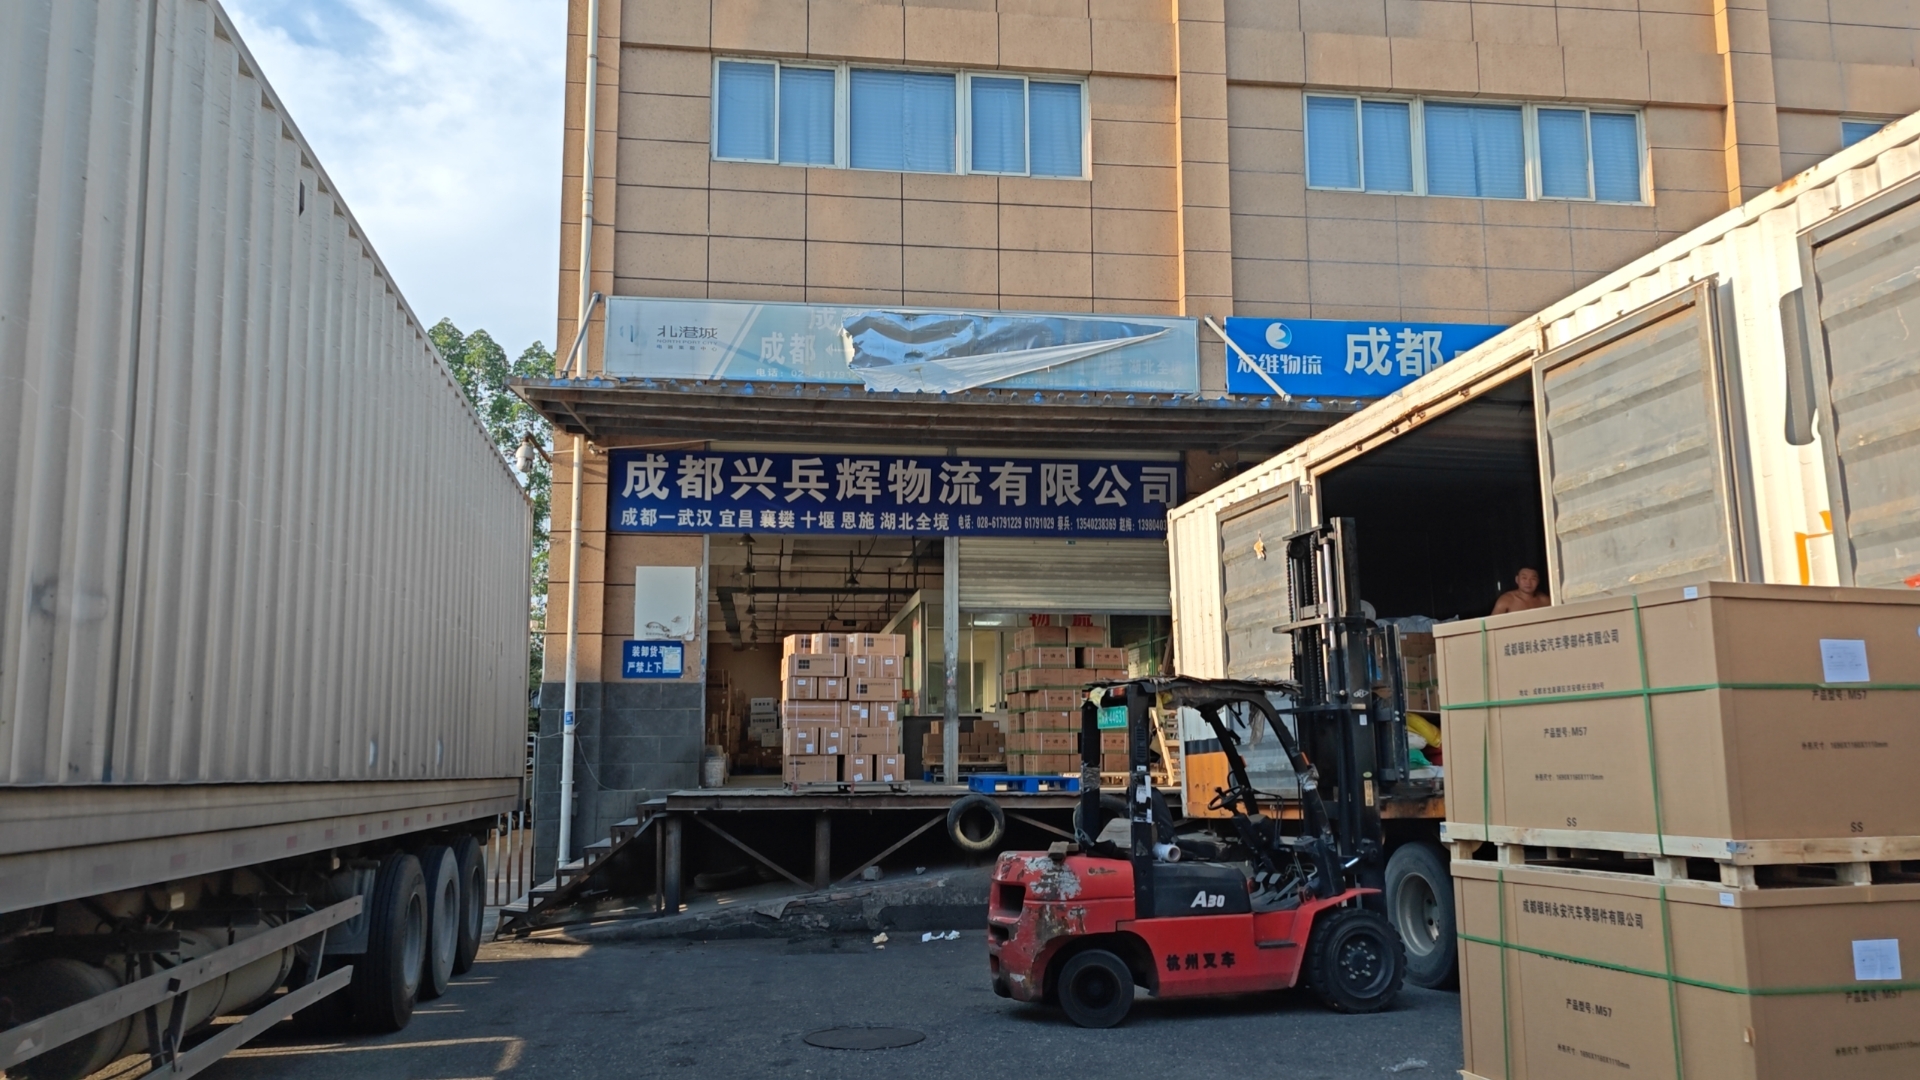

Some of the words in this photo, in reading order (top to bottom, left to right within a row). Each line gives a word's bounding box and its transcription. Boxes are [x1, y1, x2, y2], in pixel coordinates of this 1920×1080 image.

[656, 324, 718, 339] 北港城
[621, 453, 1178, 508] 成都兴兵辉物流有限公司
[719, 509, 754, 528] 宜昌
[760, 510, 795, 529] 襄樊
[801, 511, 835, 529] 十堰
[841, 512, 875, 530] 恩施
[880, 512, 949, 531] 湖北全境
[1850, 821, 1864, 833] SS
[1190, 890, 1226, 908] A30
[1166, 951, 1236, 971] 杭州叉车
